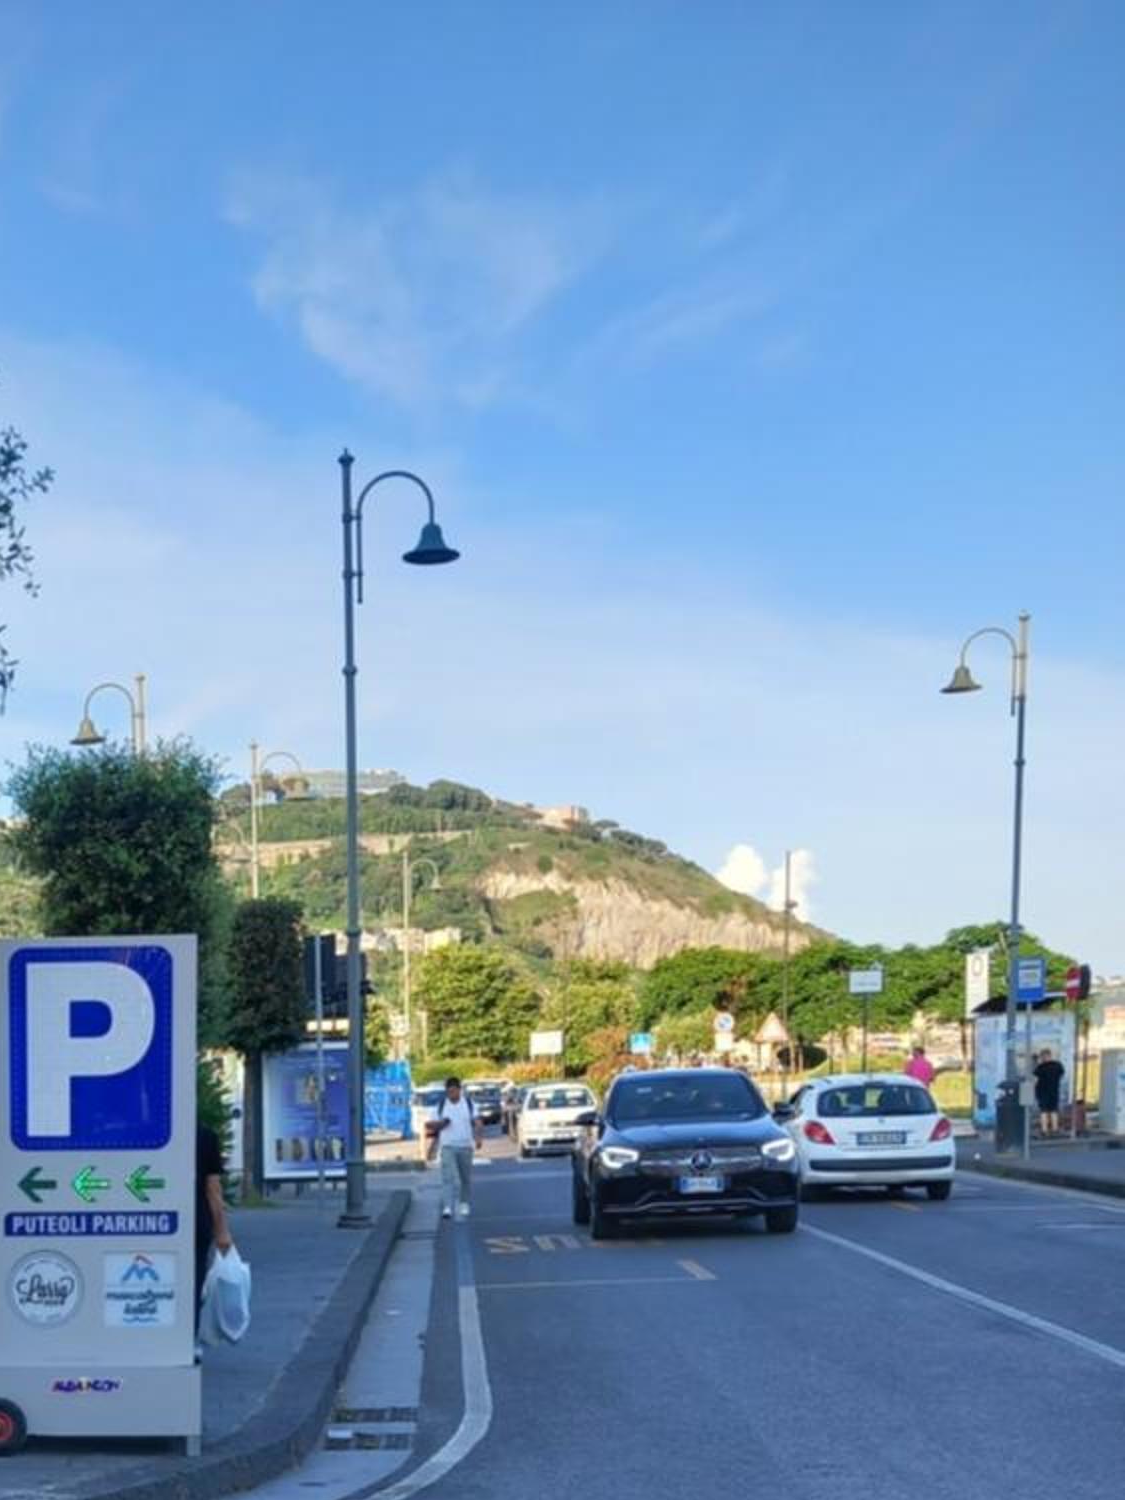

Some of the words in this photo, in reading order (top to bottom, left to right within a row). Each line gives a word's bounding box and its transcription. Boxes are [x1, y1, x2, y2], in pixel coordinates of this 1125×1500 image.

[26, 961, 155, 1137] P
[12, 1216, 86, 1233] PUTEOLI
[92, 1214, 170, 1233] PARKING
